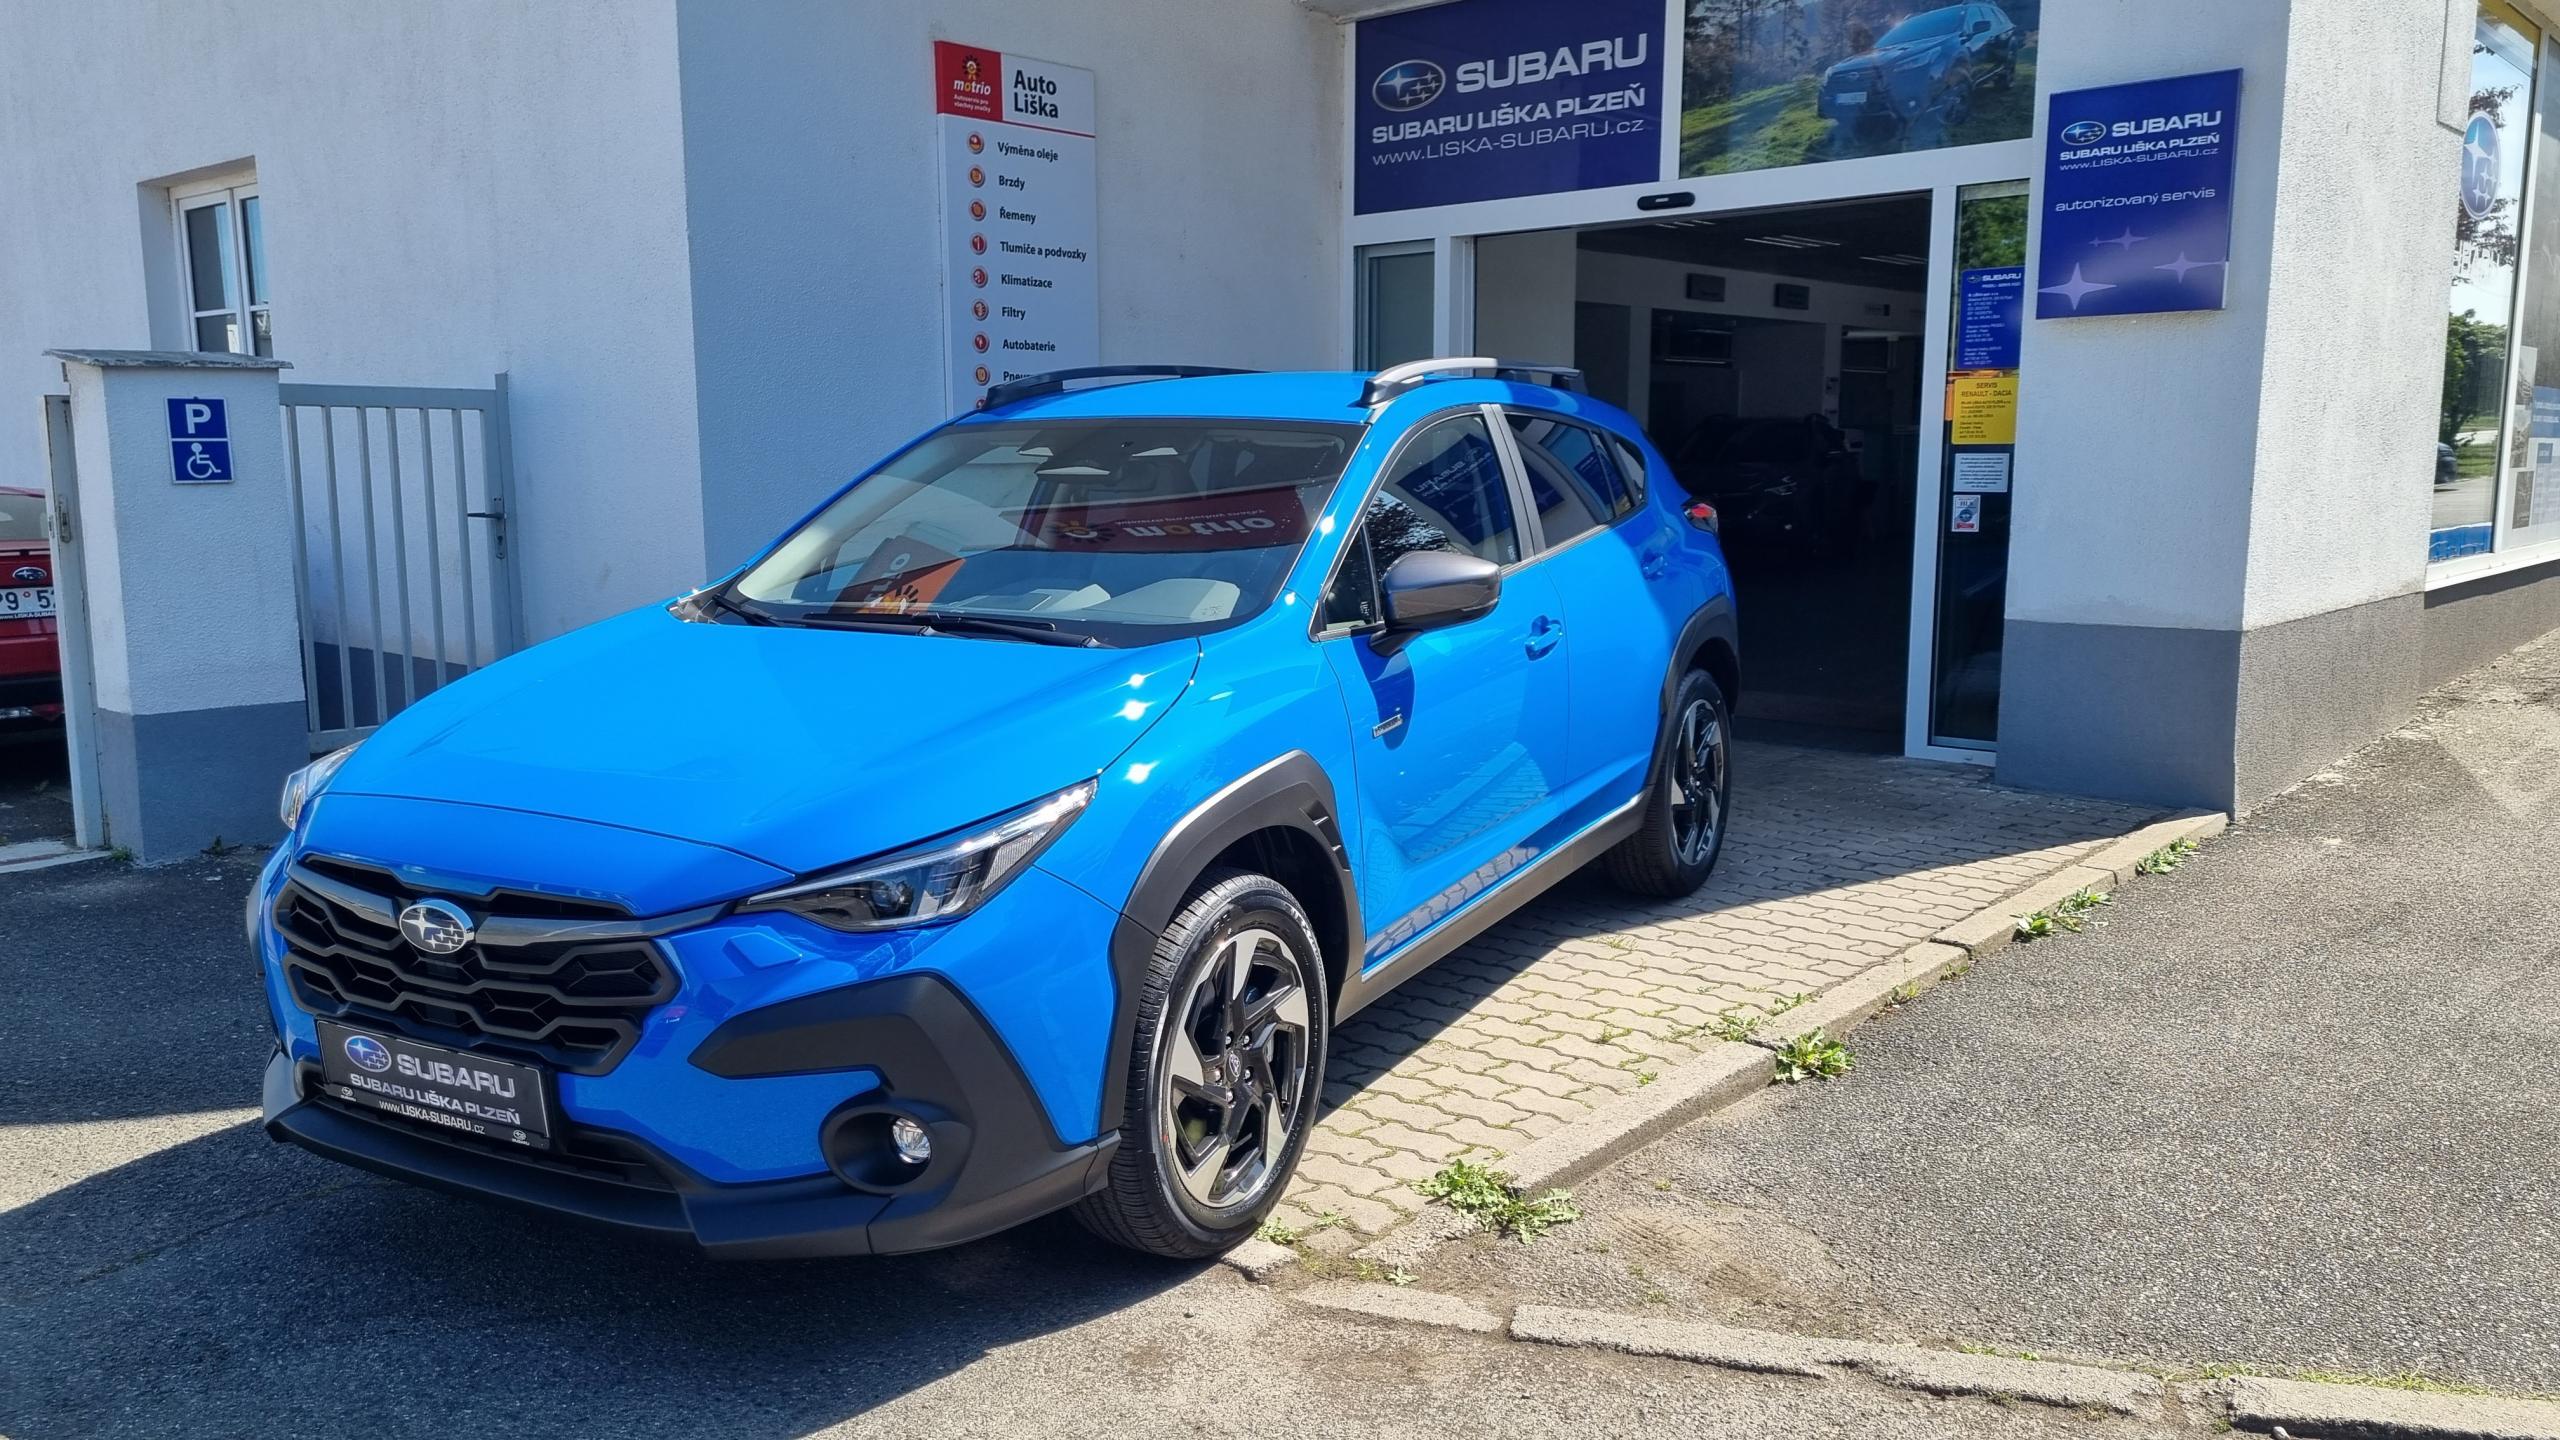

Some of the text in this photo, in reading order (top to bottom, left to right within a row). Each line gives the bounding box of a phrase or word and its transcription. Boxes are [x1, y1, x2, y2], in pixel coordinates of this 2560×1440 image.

[1455, 33, 1648, 94] SUBARU
[953, 79, 991, 96] motrio
[1014, 69, 1057, 96] Auto
[1014, 92, 1059, 119] Liška
[1372, 83, 1646, 144] SUBARU LIŠKA PLZEŇ
[2111, 110, 2222, 137] SUBARU
[997, 141, 1059, 163] Výměna oleje
[1372, 119, 1645, 166] www.LISKA-SUBARU.cz
[2059, 132, 2220, 161] SUBARU LIŠKA PLZEŇ
[2059, 148, 2219, 171] www.LISKA-SUBARU.cz
[998, 175, 1025, 191] Brzdy
[2055, 187, 2216, 212] autorizovaný servis
[999, 206, 1036, 224] Řemeny
[1000, 241, 1087, 262] Tlumiče a podvozky
[1001, 274, 1053, 289] Klimatizace
[1001, 306, 1026, 320] Filtry
[1002, 338, 1056, 352] Autobaterie
[185, 403, 211, 434] P
[396, 1053, 516, 1099] SUBARU
[350, 1073, 521, 1126] SUBARU LIŠKA PLZEŇ
[378, 1100, 486, 1135] www.LISKA-SUBARU.cz
